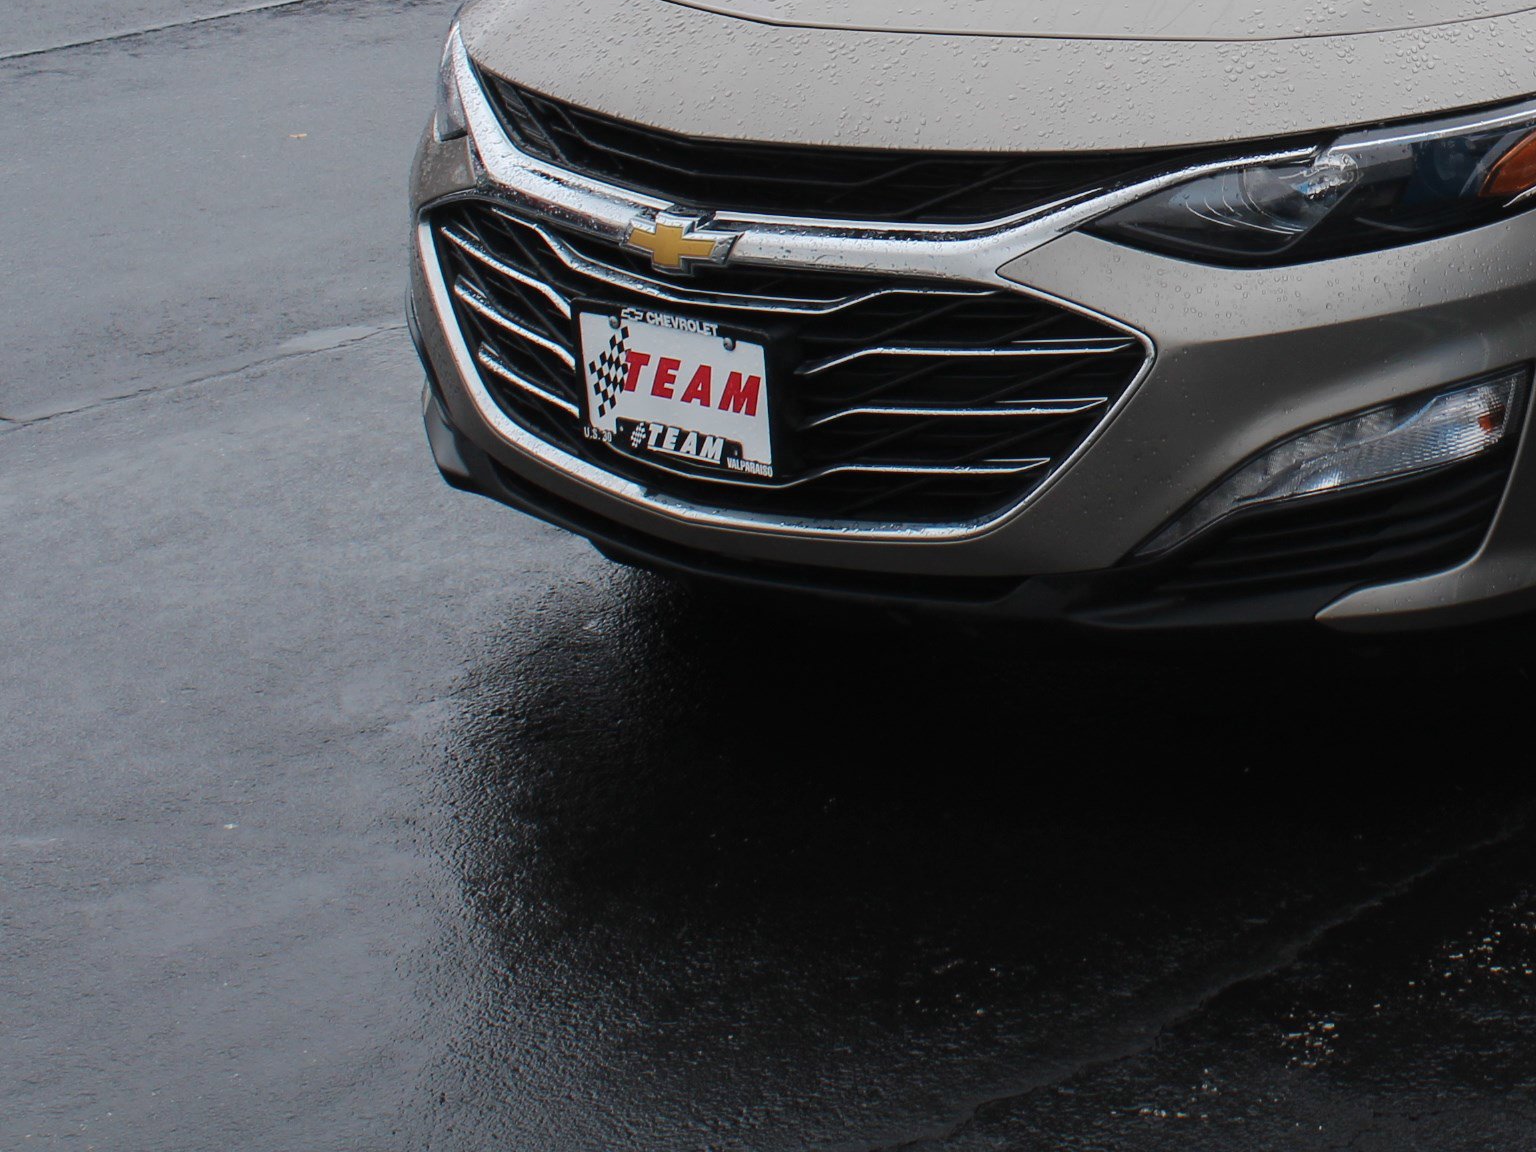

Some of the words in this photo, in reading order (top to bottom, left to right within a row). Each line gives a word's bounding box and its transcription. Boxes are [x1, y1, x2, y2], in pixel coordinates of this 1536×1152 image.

[645, 311, 718, 337] CHEVROLET
[624, 349, 761, 417] TEAM
[583, 426, 601, 440] U.S.
[647, 422, 725, 463] TEAM
[726, 456, 774, 478] VALPARAISO
